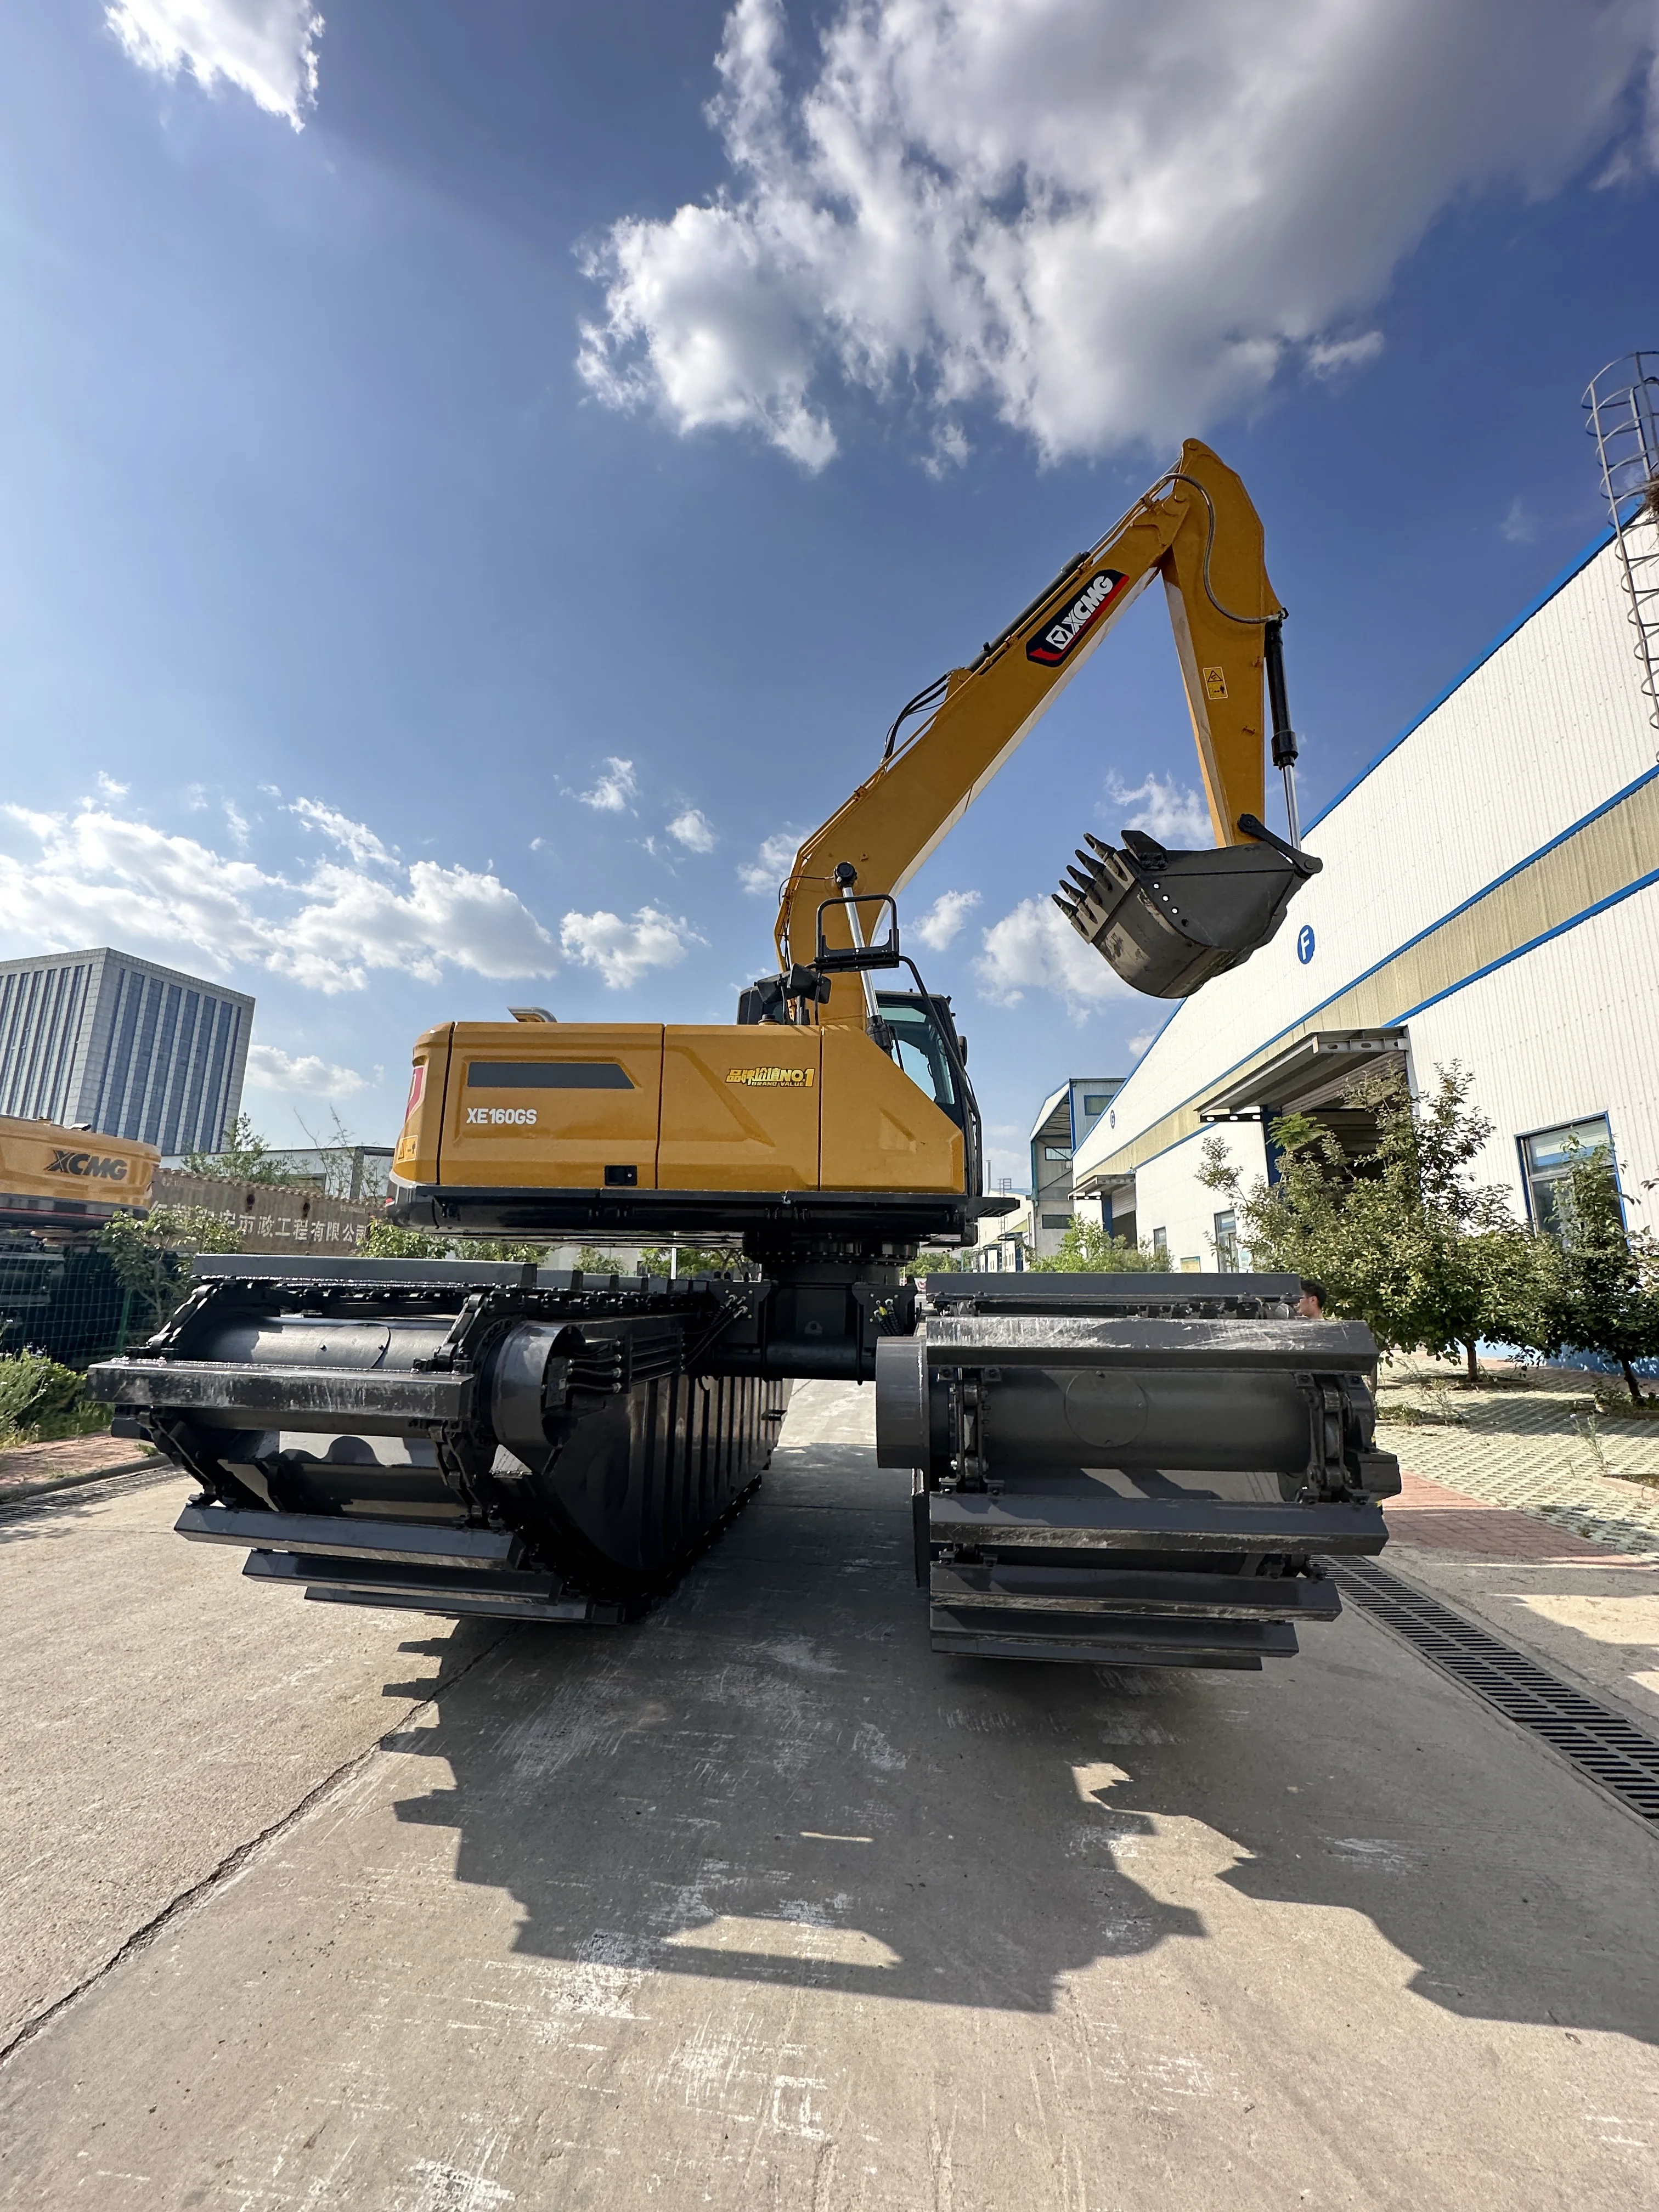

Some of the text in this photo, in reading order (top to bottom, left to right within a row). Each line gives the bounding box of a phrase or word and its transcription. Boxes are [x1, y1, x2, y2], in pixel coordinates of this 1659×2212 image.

[1062, 576, 1113, 635] XCMG
[1300, 929, 1310, 961] F
[466, 1108, 537, 1125] XE160GS
[43, 1149, 127, 1180] XCMG
